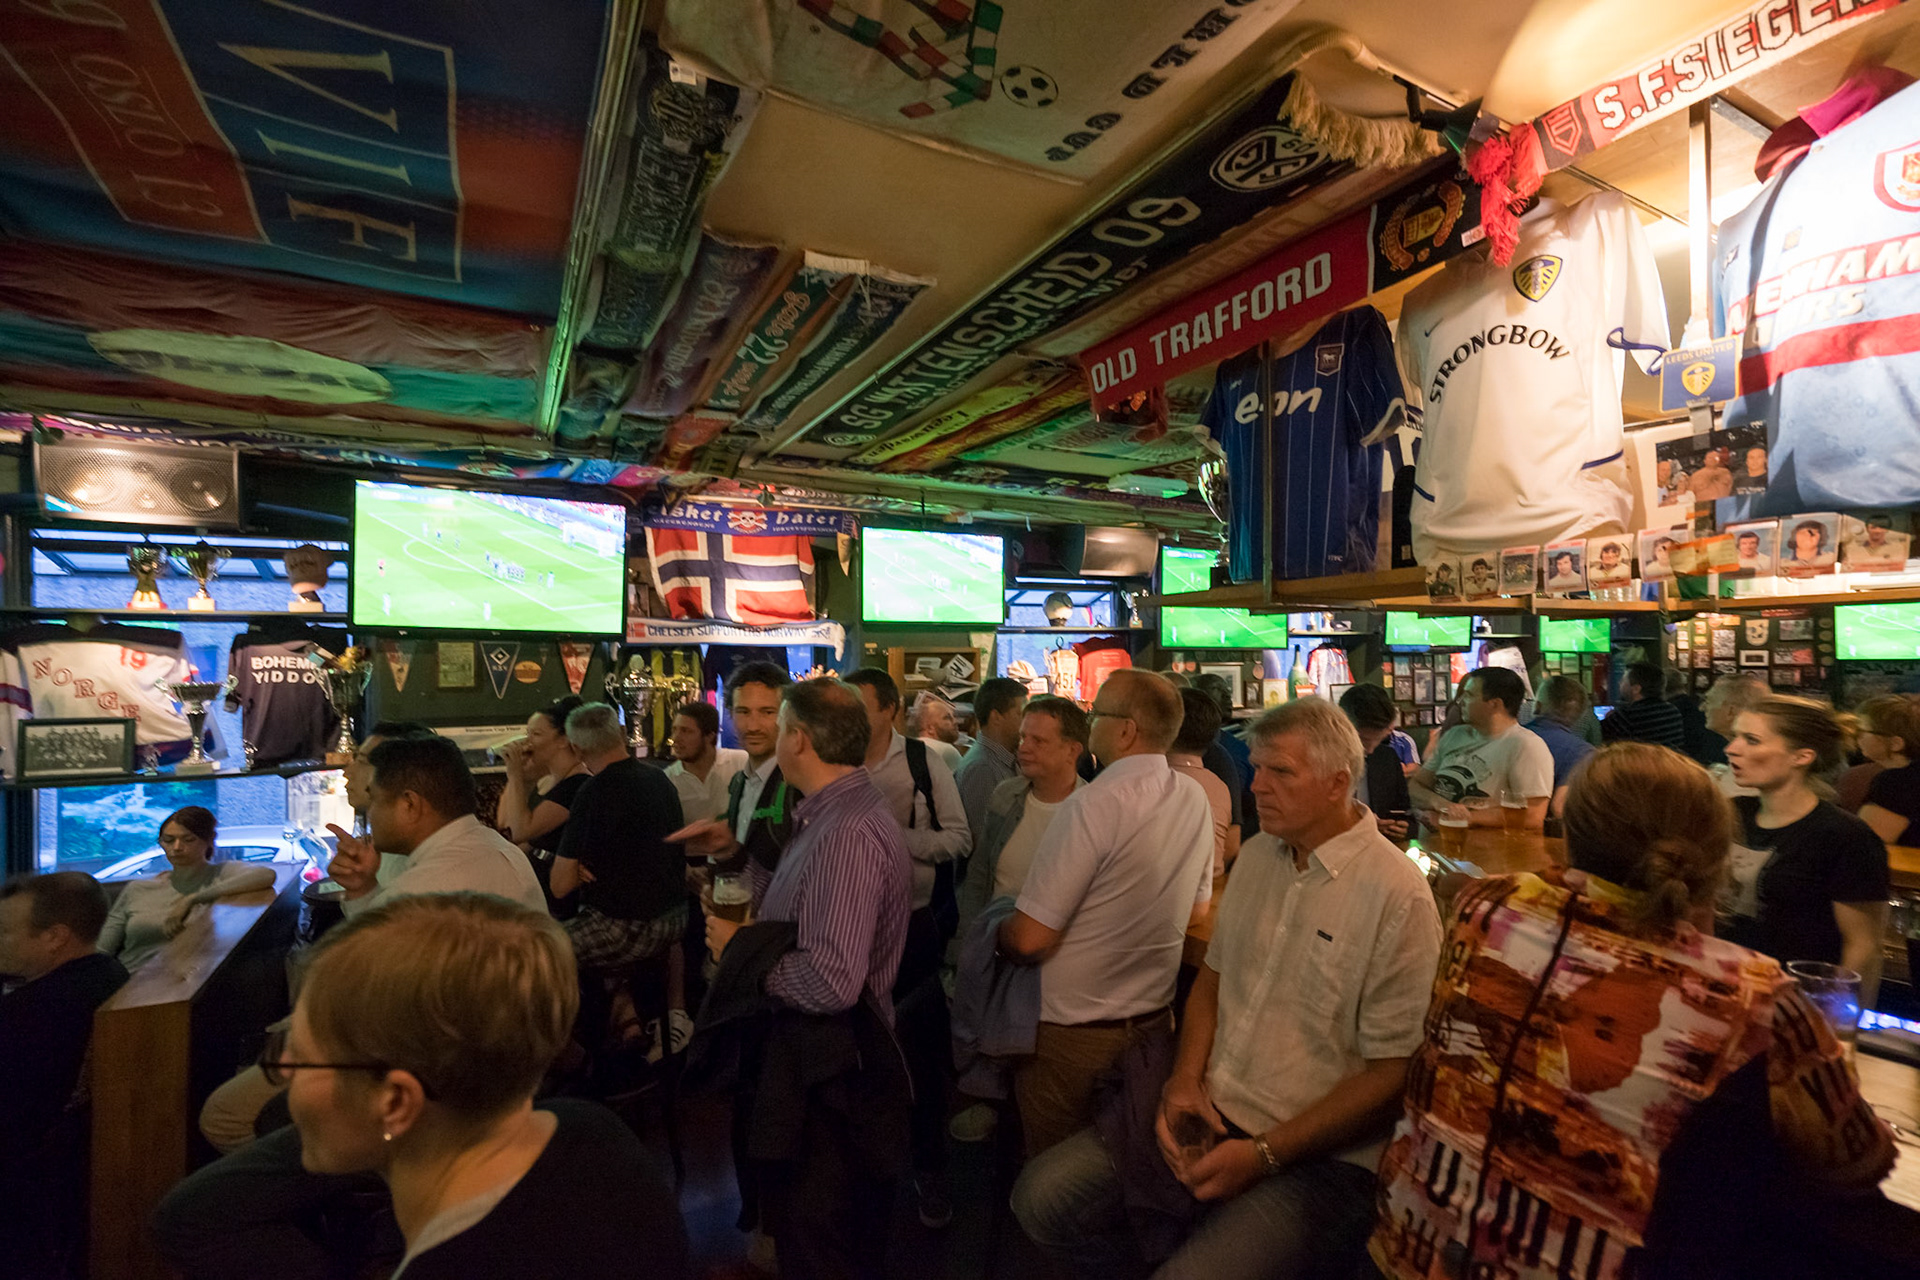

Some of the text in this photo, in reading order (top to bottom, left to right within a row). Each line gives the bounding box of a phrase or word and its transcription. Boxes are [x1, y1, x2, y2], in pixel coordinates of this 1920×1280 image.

[840, 404, 894, 430] SG
[1092, 197, 1200, 248] 09
[1091, 347, 1137, 394] OLD
[1150, 252, 1331, 366] TRAFFORD
[1429, 324, 1570, 404] STRONGBOW
[1666, 351, 1694, 365] LEEDS
[1697, 342, 1734, 358] UNITED
[648, 626, 807, 638] CHELSEA SUPPORTERS NORWAY
[33, 658, 141, 722] NORGE
